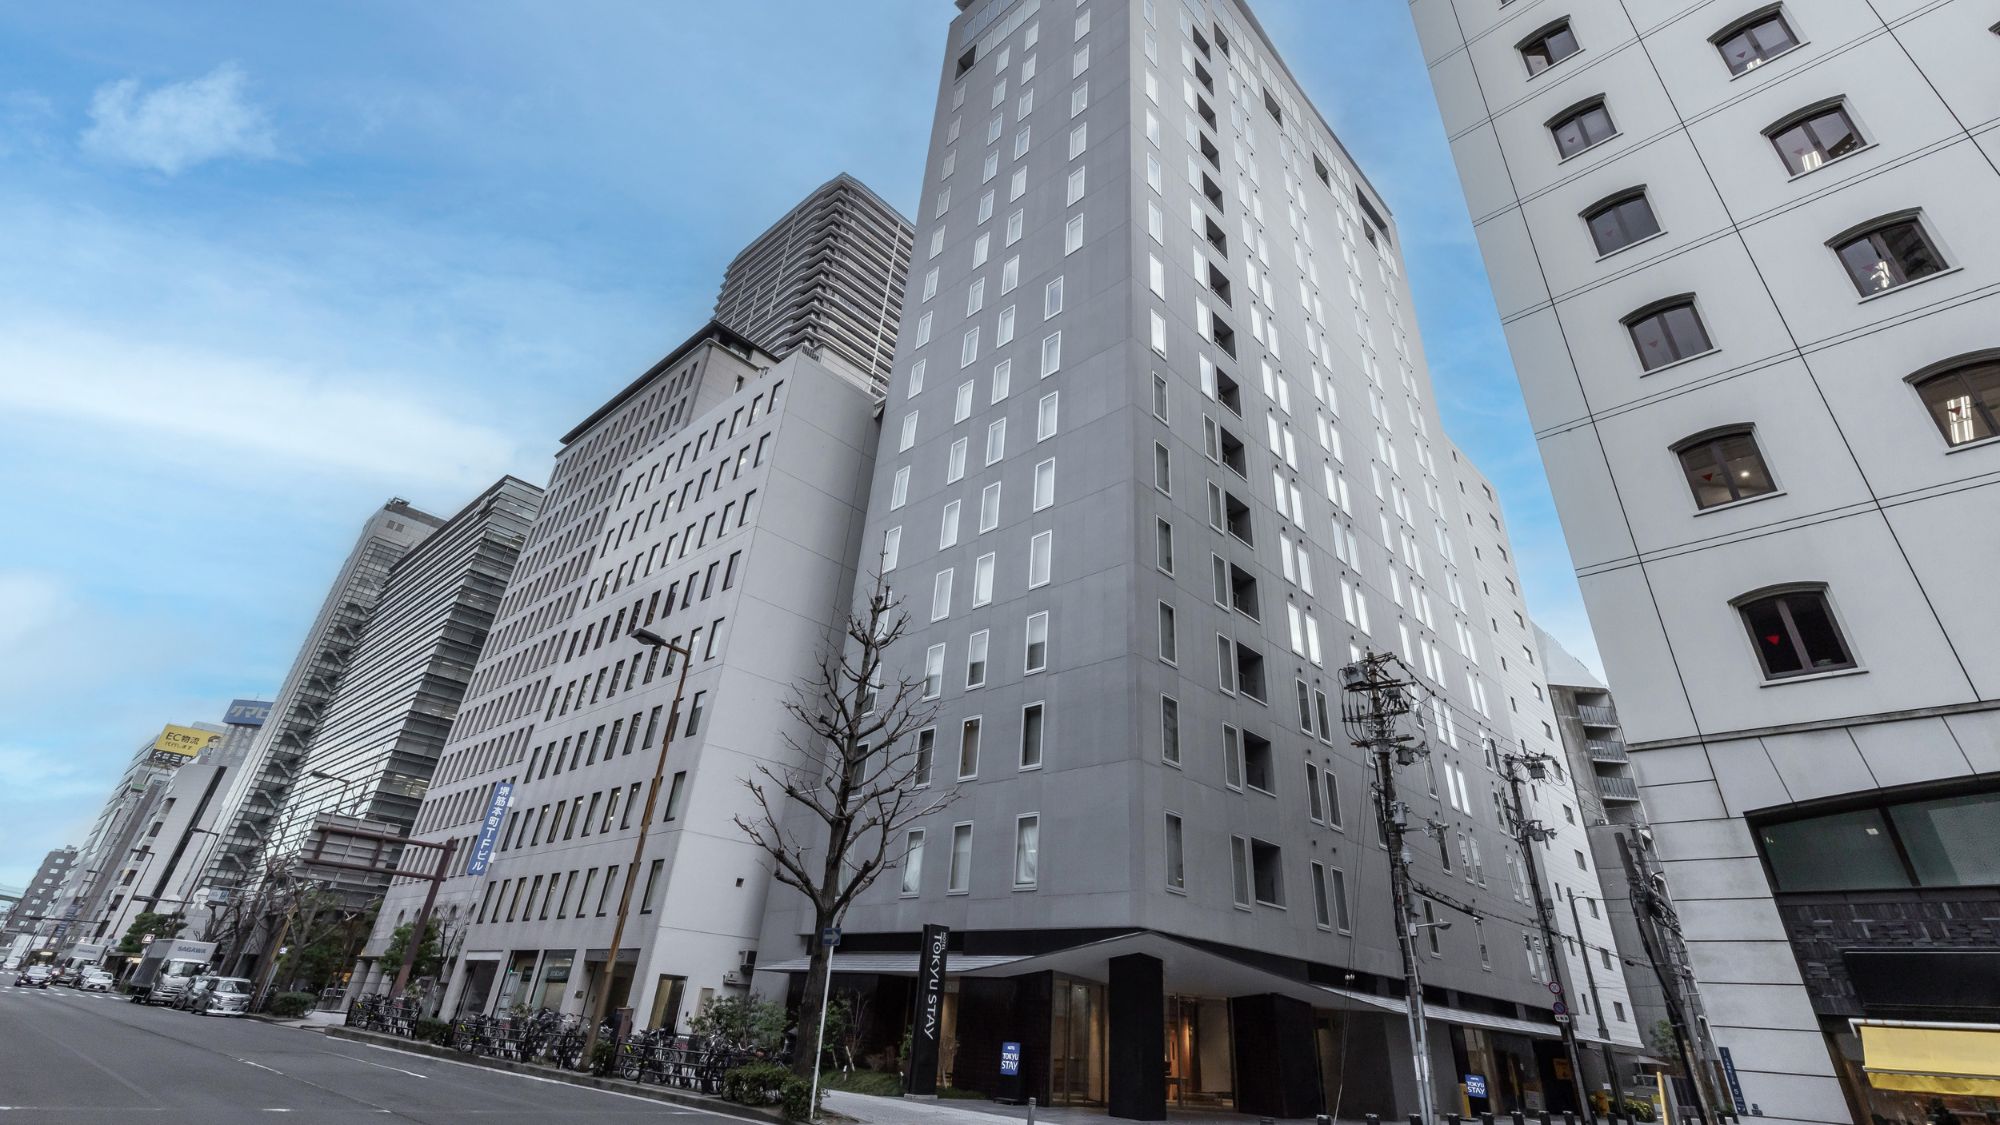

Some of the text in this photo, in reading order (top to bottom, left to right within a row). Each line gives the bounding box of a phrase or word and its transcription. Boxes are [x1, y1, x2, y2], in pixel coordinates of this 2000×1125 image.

[165, 731, 200, 745] EC物流
[924, 931, 943, 1040] TOKYU STAY
[1002, 1052, 1019, 1061] TOKYU
[1001, 1060, 1019, 1071] STAY
[1467, 1086, 1485, 1095] STAY
